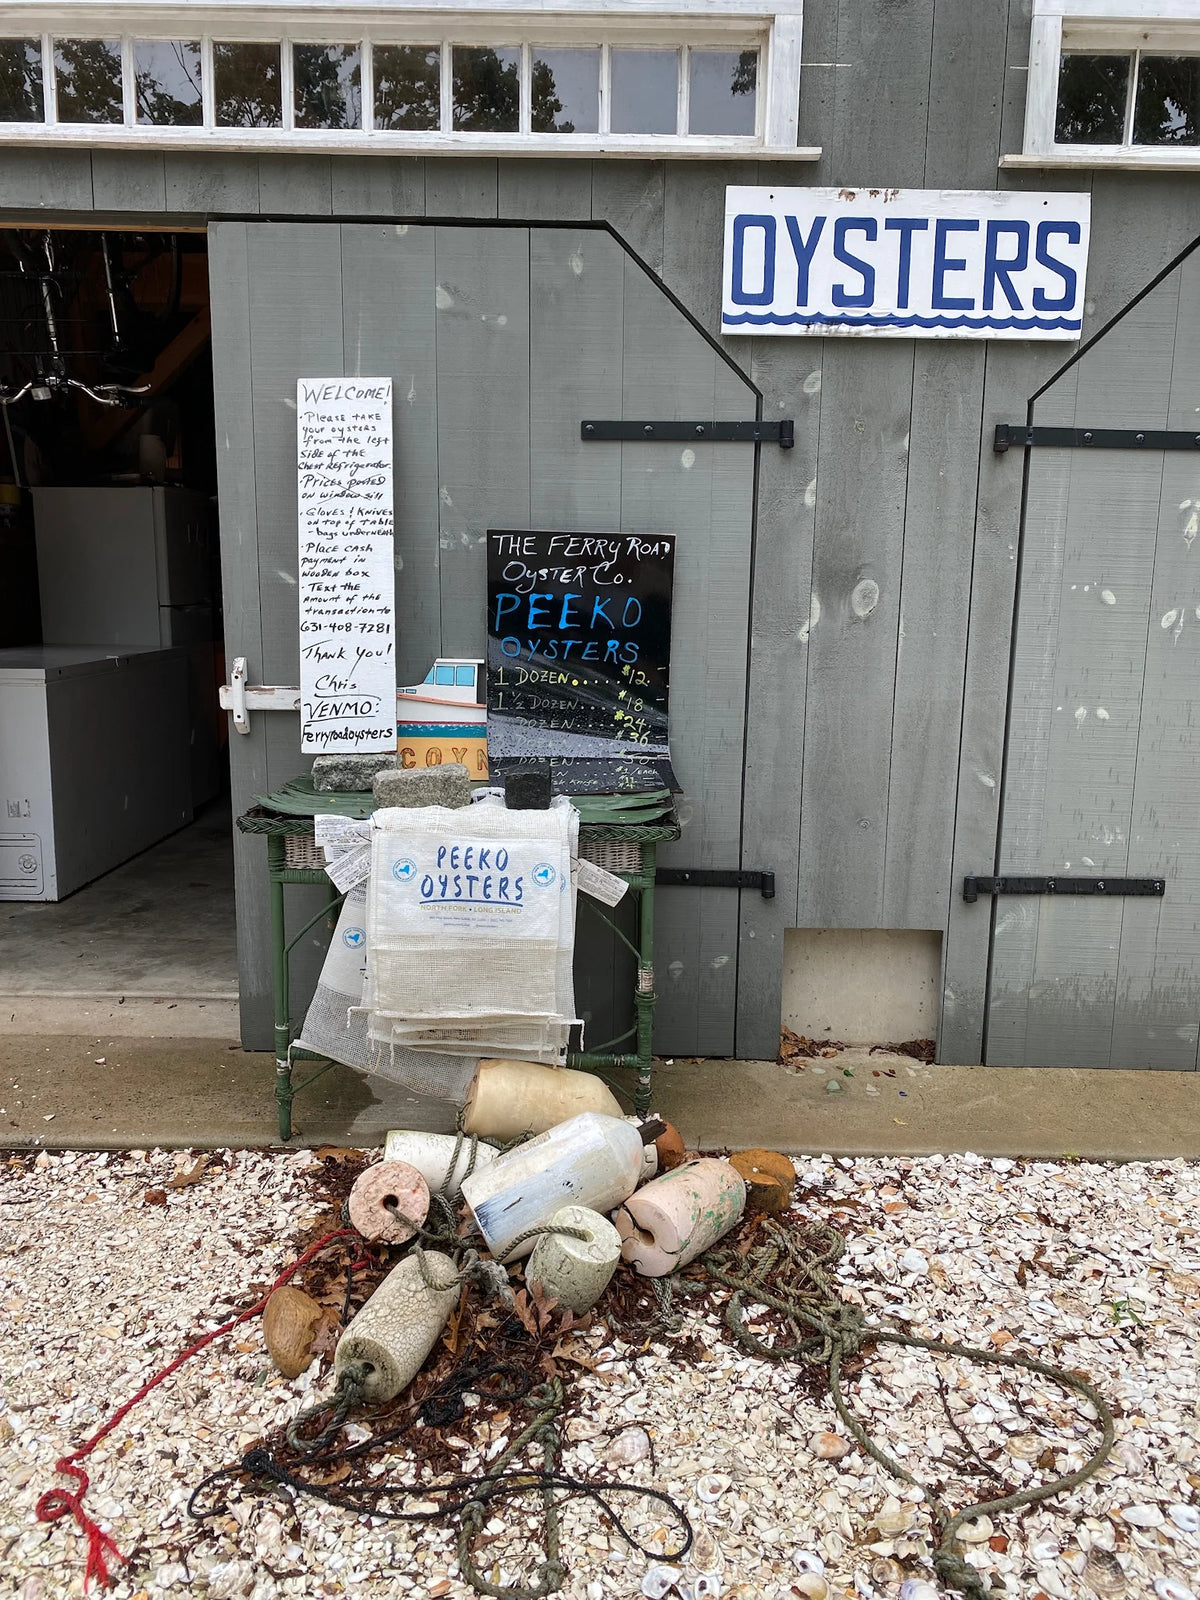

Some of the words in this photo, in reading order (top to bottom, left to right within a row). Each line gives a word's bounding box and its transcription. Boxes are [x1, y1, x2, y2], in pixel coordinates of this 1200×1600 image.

[731, 214, 1081, 311] OYSTERS
[492, 534, 538, 557] THE
[495, 592, 642, 632] PEEKO
[300, 620, 391, 635] 631-408-7281
[500, 636, 640, 664] OYSTERS
[315, 674, 358, 693] Chris
[494, 666, 509, 686] 1
[435, 845, 509, 872] PEEKO
[419, 874, 524, 901] OYSTERS
[420, 904, 447, 912] NORTH
[448, 905, 468, 913] FORK
[473, 906, 494, 914] LONG
[494, 907, 522, 915] ISLAND
